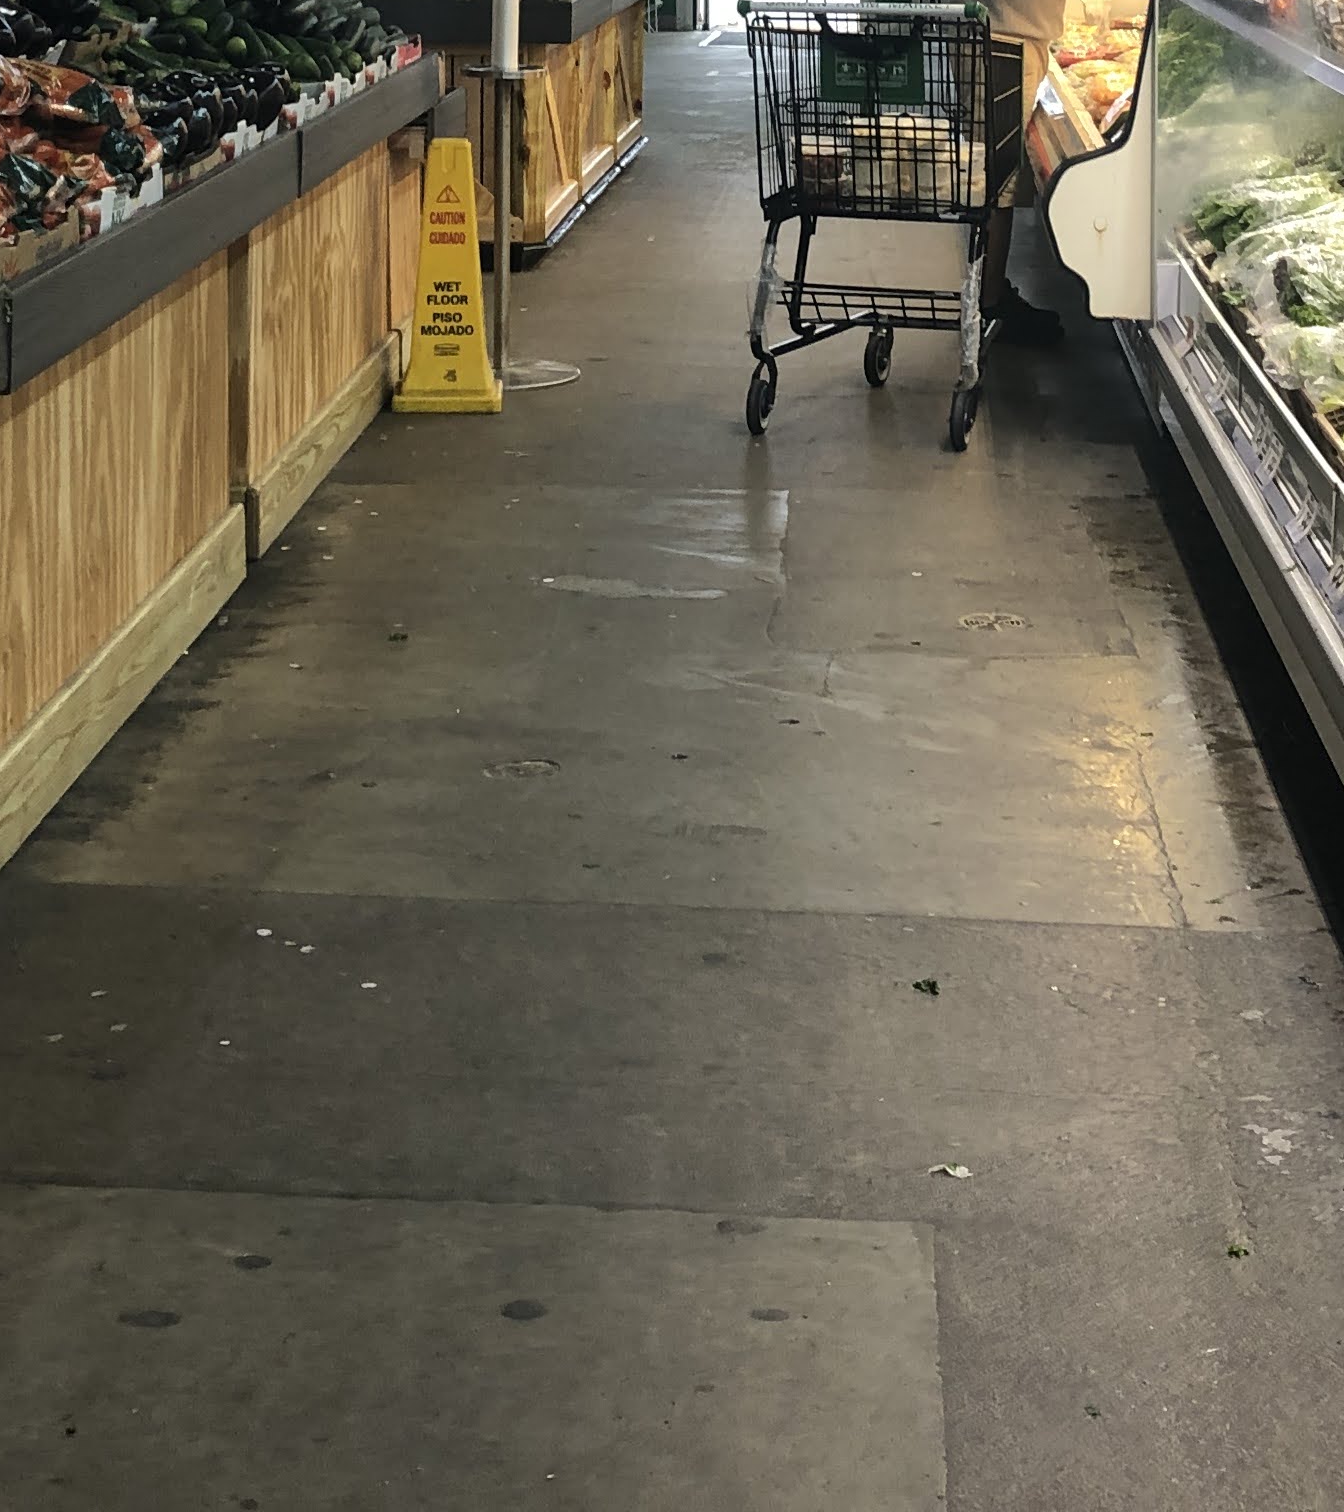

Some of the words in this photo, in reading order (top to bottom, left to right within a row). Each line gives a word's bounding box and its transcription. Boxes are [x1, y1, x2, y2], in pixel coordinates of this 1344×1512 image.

[429, 211, 466, 226] CAUTION
[429, 231, 466, 245] CUIDADO
[433, 282, 462, 292] WET
[426, 295, 469, 306] FLOOR
[432, 312, 463, 323] PISO
[420, 325, 474, 336] MOJADO
